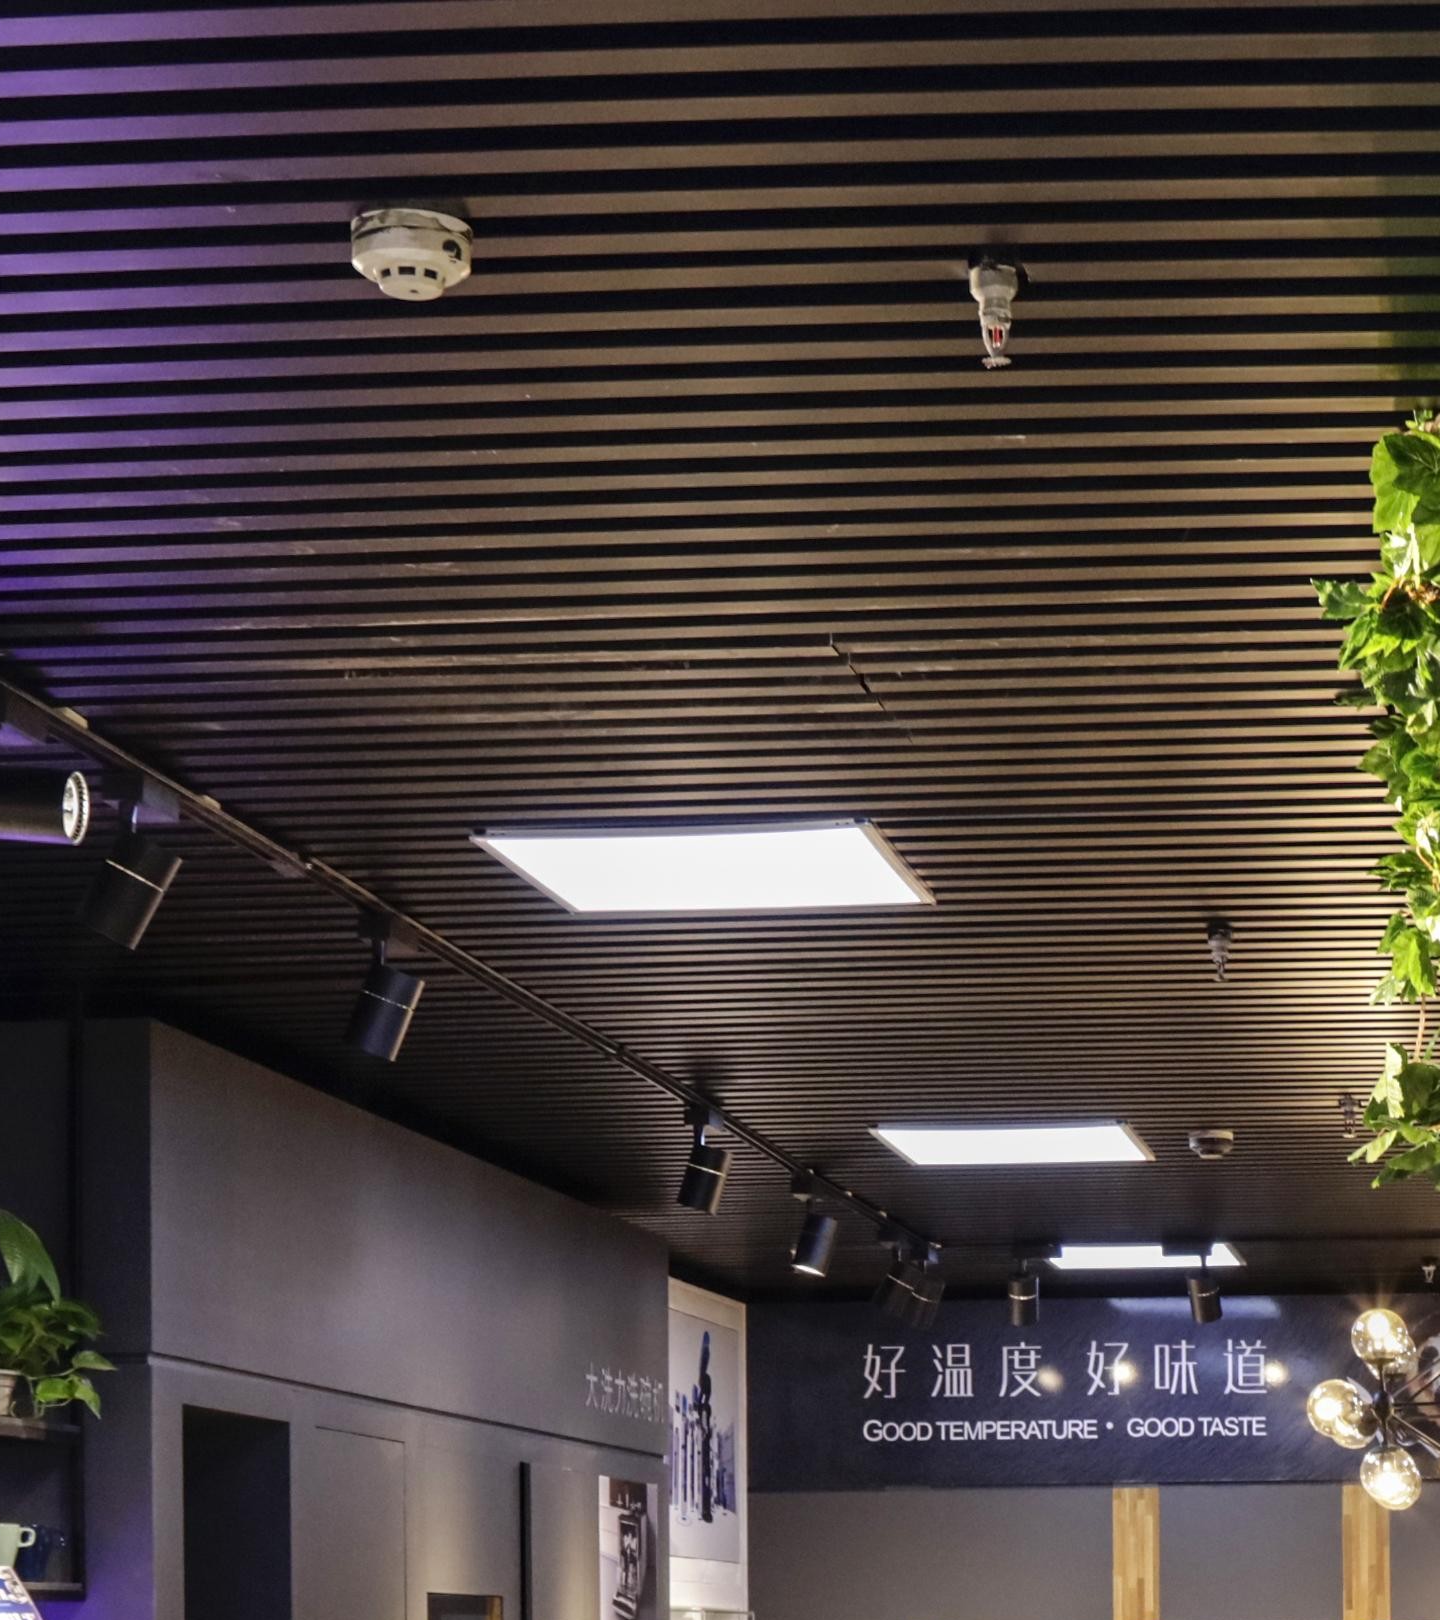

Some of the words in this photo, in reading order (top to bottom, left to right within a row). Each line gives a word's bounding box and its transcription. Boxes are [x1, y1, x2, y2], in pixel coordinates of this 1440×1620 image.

[862, 1341, 1042, 1399] 好温度
[1086, 1337, 1268, 1396] 好味道
[862, 1418, 932, 1442] GOOD
[936, 1417, 1098, 1441] TEMPERATURE
[1126, 1415, 1195, 1438] GOOD
[1197, 1415, 1268, 1437] TASTE
